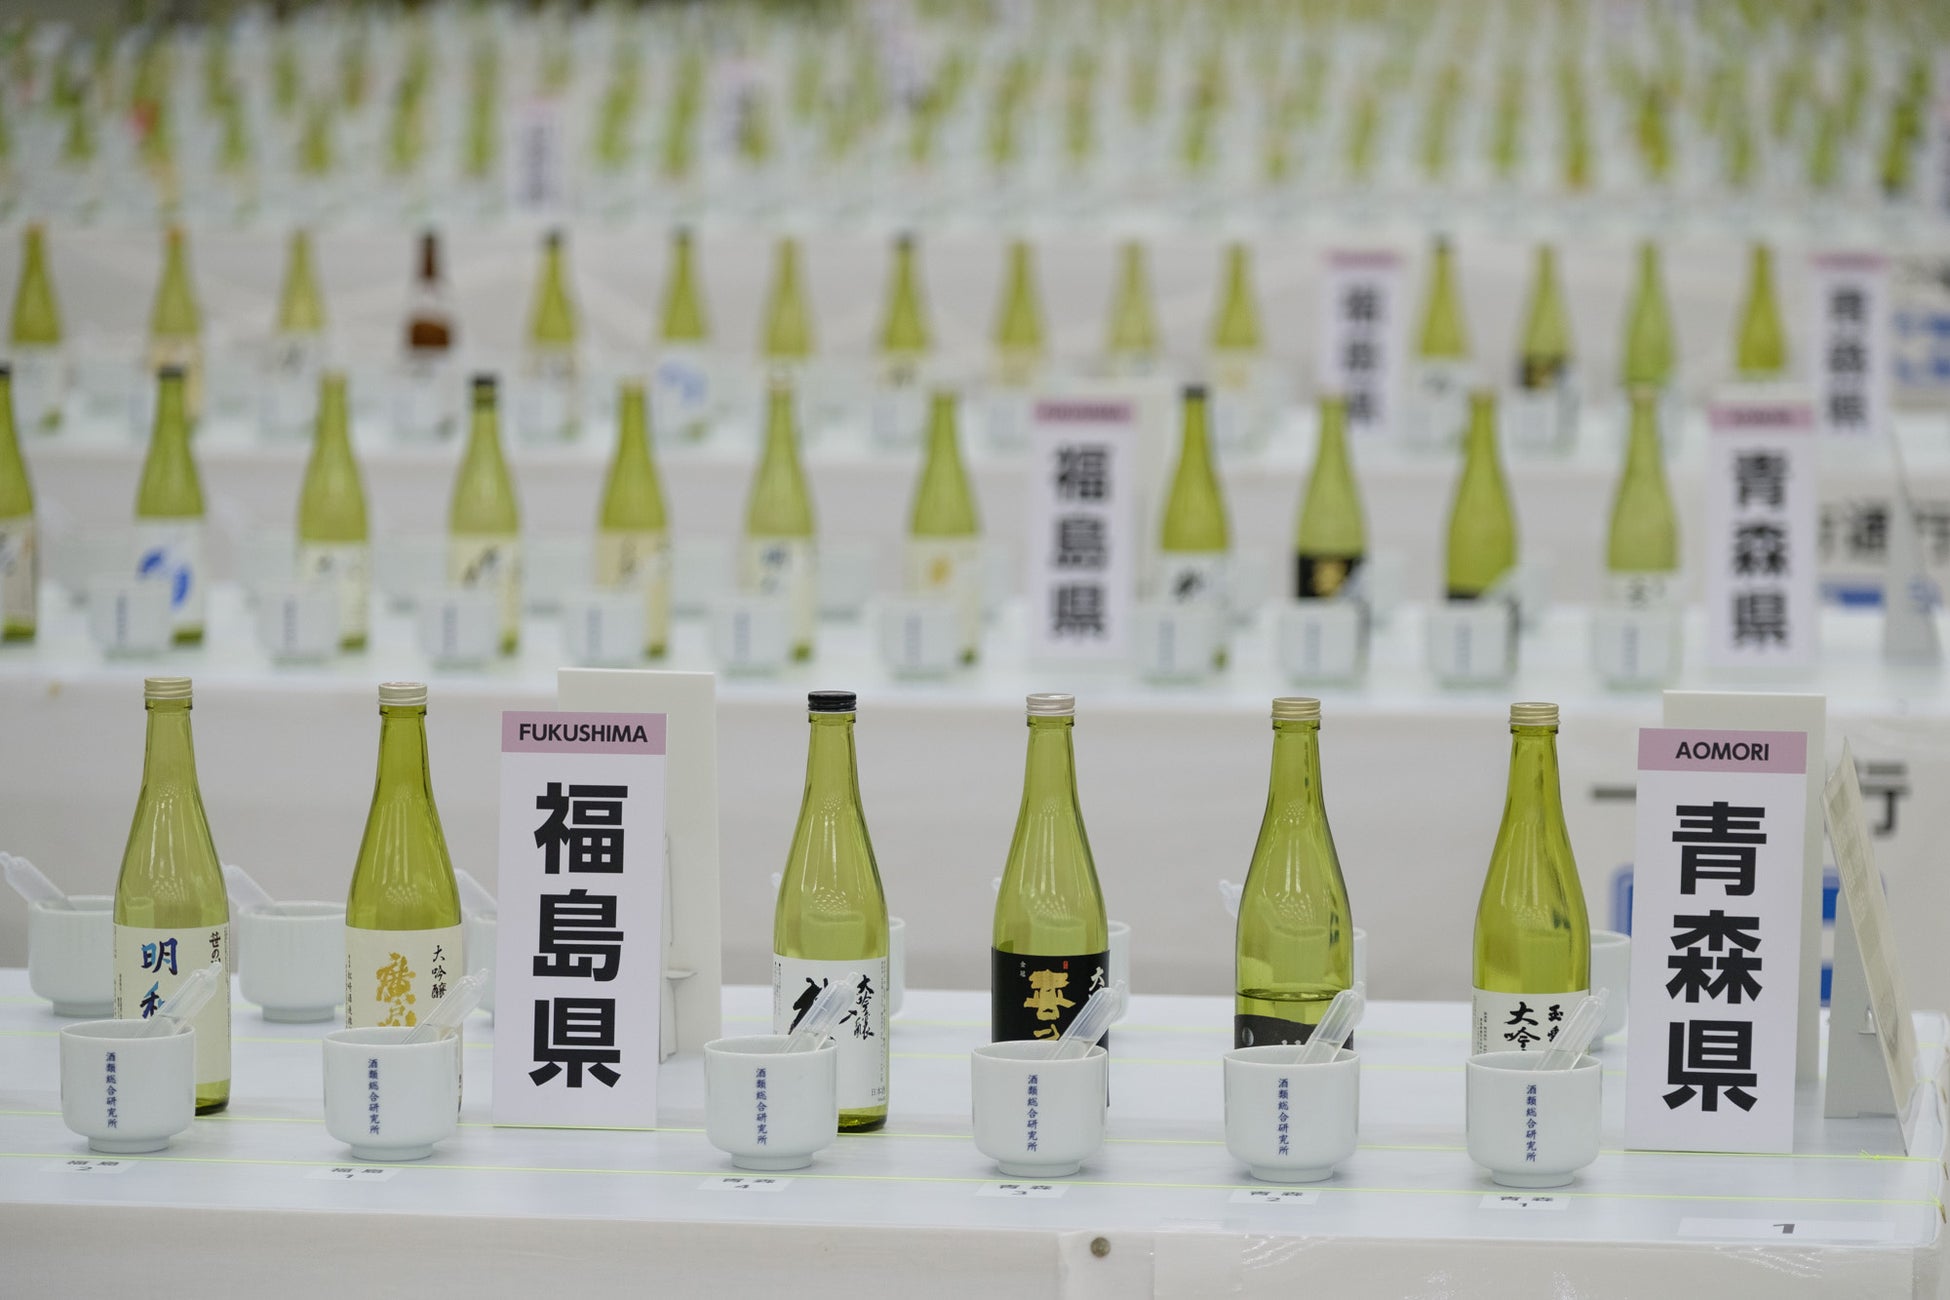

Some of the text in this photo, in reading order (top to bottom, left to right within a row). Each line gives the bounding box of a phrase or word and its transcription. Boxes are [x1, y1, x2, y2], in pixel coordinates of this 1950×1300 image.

[519, 723, 648, 743] FUKUSHIMA
[1675, 741, 1770, 761] AOMORI
[209, 931, 221, 963] 笹の
[528, 782, 628, 1089] 福島県
[1662, 801, 1767, 1112] 青森県
[106, 1052, 117, 1128] 酒類総合研究所
[368, 1059, 380, 1135] 酒類総合研究所
[756, 1068, 767, 1145] 酒類総合研究所
[1027, 1075, 1038, 1152] 酒類総合研究所
[1278, 1078, 1289, 1156] 酒類総合研究所
[1526, 1084, 1537, 1162] 酒類総合研究所
[1772, 1223, 1796, 1234] 1
